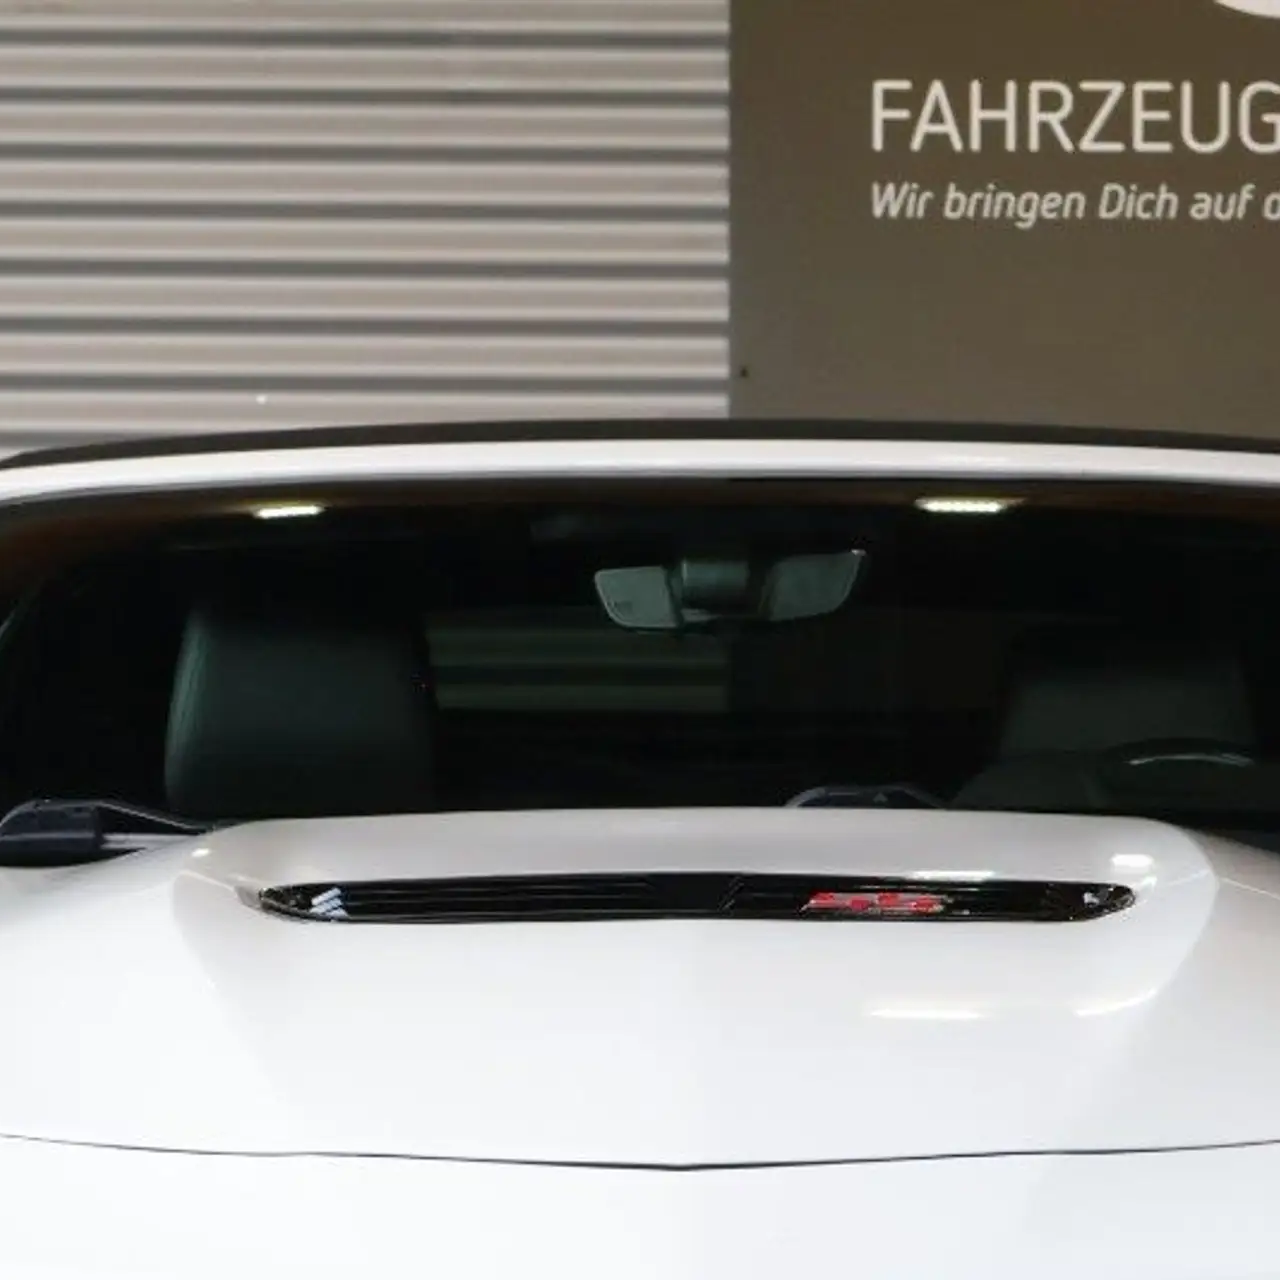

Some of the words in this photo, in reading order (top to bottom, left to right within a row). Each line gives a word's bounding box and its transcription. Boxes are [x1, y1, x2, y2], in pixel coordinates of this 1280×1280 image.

[870, 182, 933, 220] Wir
[943, 182, 1086, 230] bringen
[1098, 182, 1179, 220] Dich
[1188, 183, 1255, 221] auf
